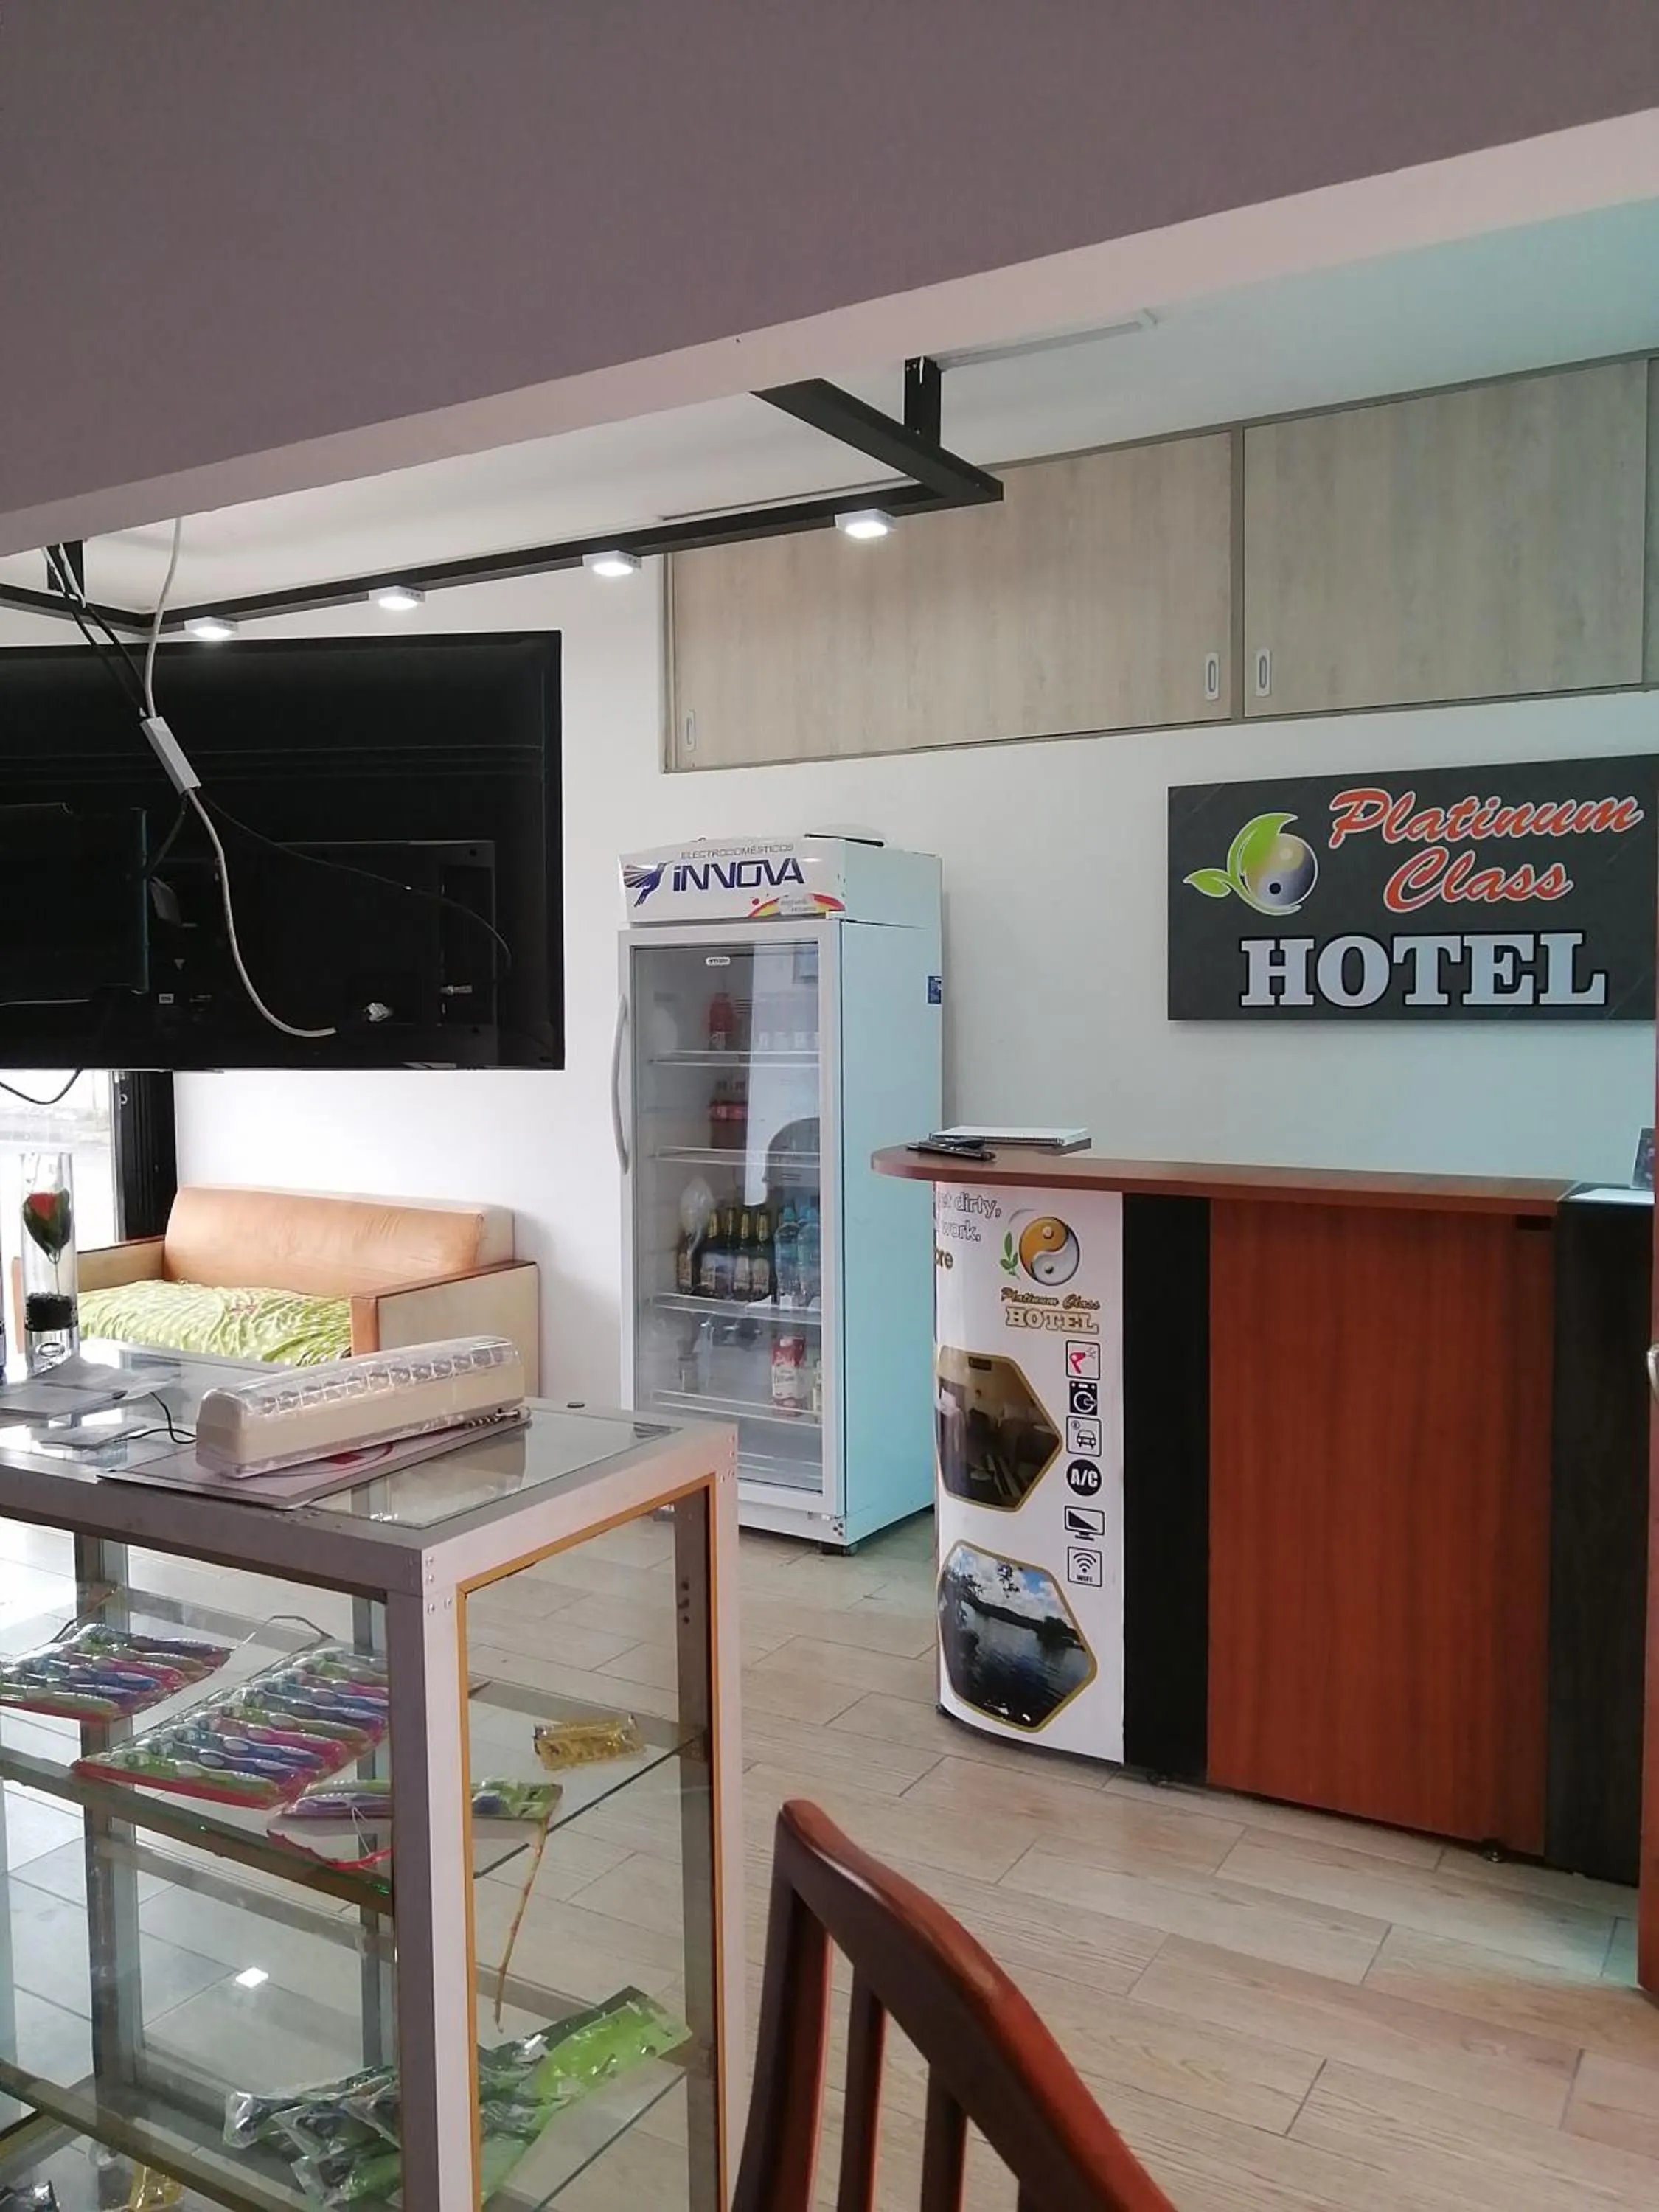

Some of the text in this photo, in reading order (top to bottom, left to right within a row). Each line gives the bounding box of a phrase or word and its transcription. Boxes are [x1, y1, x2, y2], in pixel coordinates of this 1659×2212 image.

[1329, 787, 1644, 849] Platinum
[1383, 846, 1574, 913] Class
[1239, 931, 1608, 1007] HOTEL
[1001, 1287, 1101, 1310] Platinum Class
[1005, 1306, 1099, 1335] HOTEL
[1071, 1468, 1098, 1487] A/C
